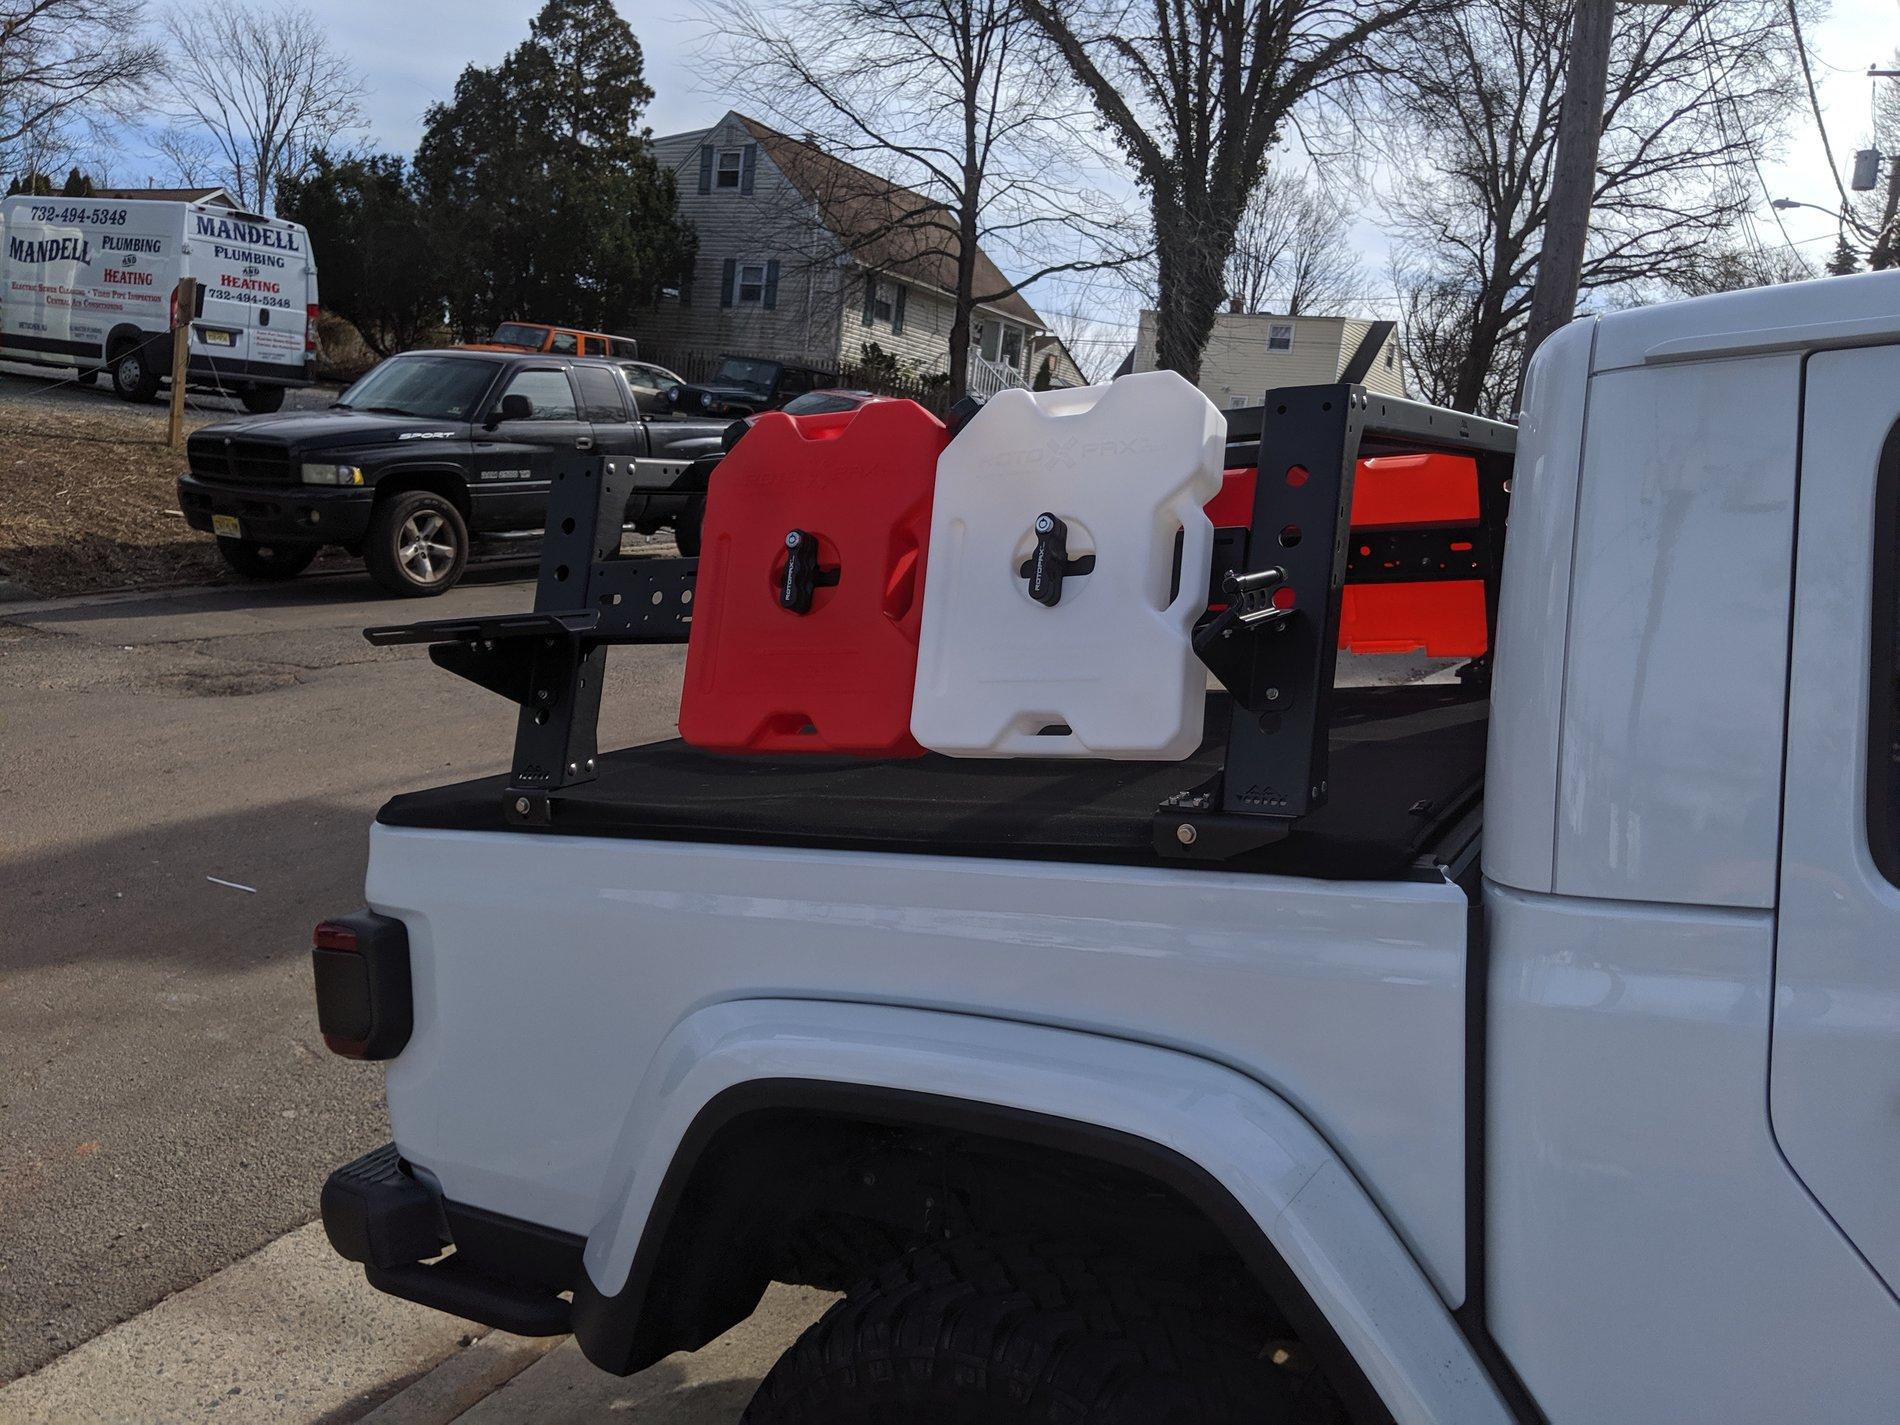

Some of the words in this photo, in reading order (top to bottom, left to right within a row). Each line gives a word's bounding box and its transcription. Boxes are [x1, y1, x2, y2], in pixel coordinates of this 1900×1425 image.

[31, 206, 127, 225] 732-494-5348
[196, 216, 299, 251] MANDELL
[9, 236, 91, 266] MANDELL
[102, 235, 161, 253] PLUMBING
[214, 245, 285, 268] PLUMBING
[104, 268, 152, 285] HEATING
[220, 274, 280, 293] HEATING
[399, 432, 455, 440] SPORT
